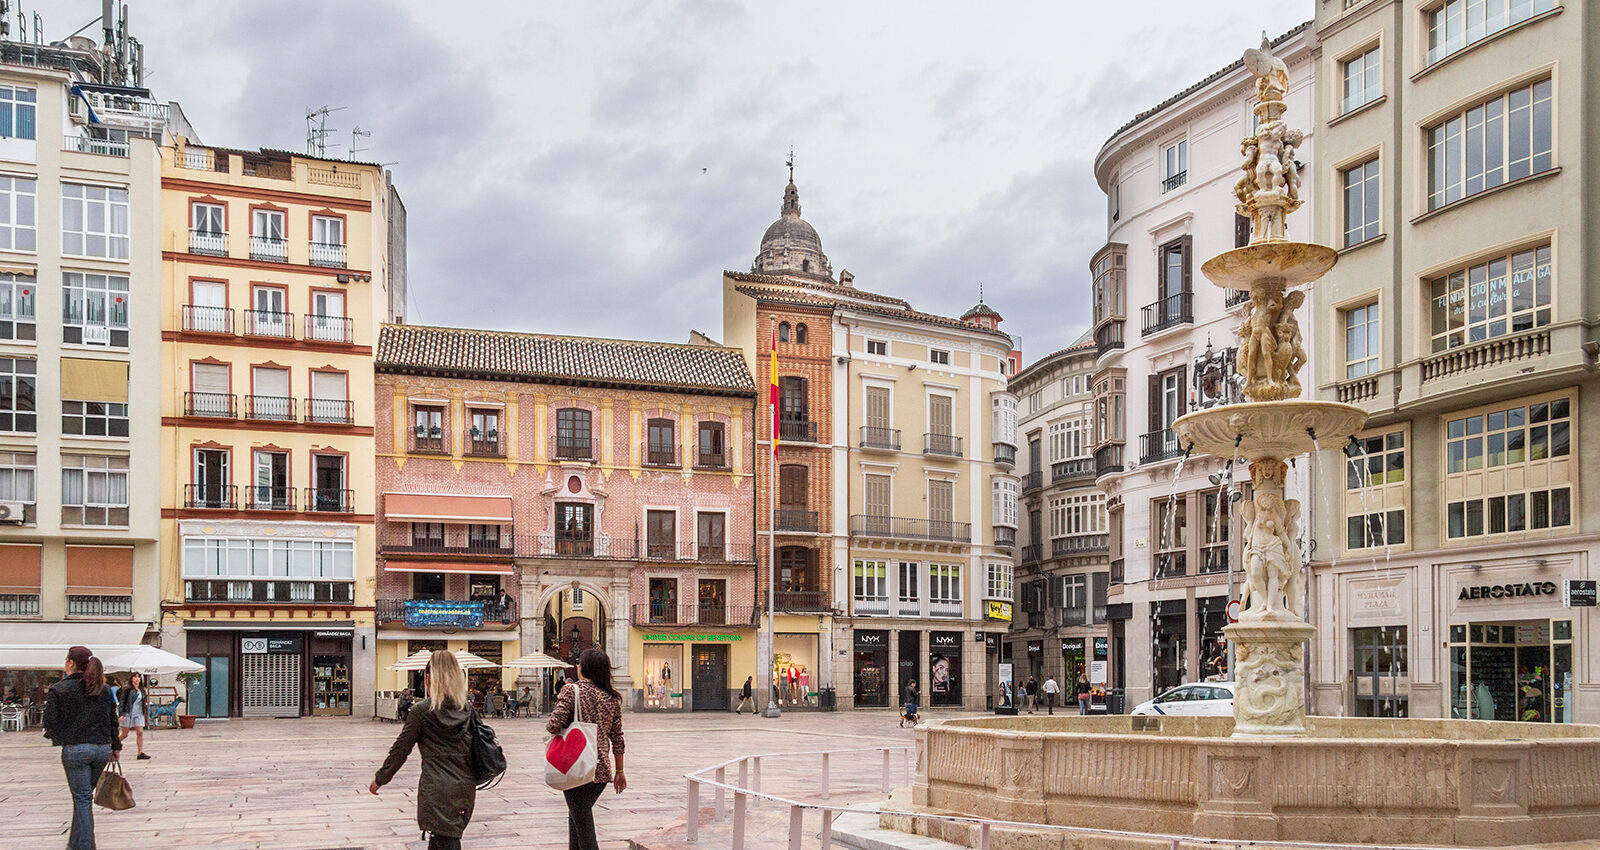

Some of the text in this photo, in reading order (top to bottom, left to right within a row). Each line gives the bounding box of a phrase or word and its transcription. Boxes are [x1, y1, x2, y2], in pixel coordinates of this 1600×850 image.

[1458, 581, 1557, 600] AEROSTATO
[861, 635, 880, 644] NYX
[936, 636, 954, 645] NYX
